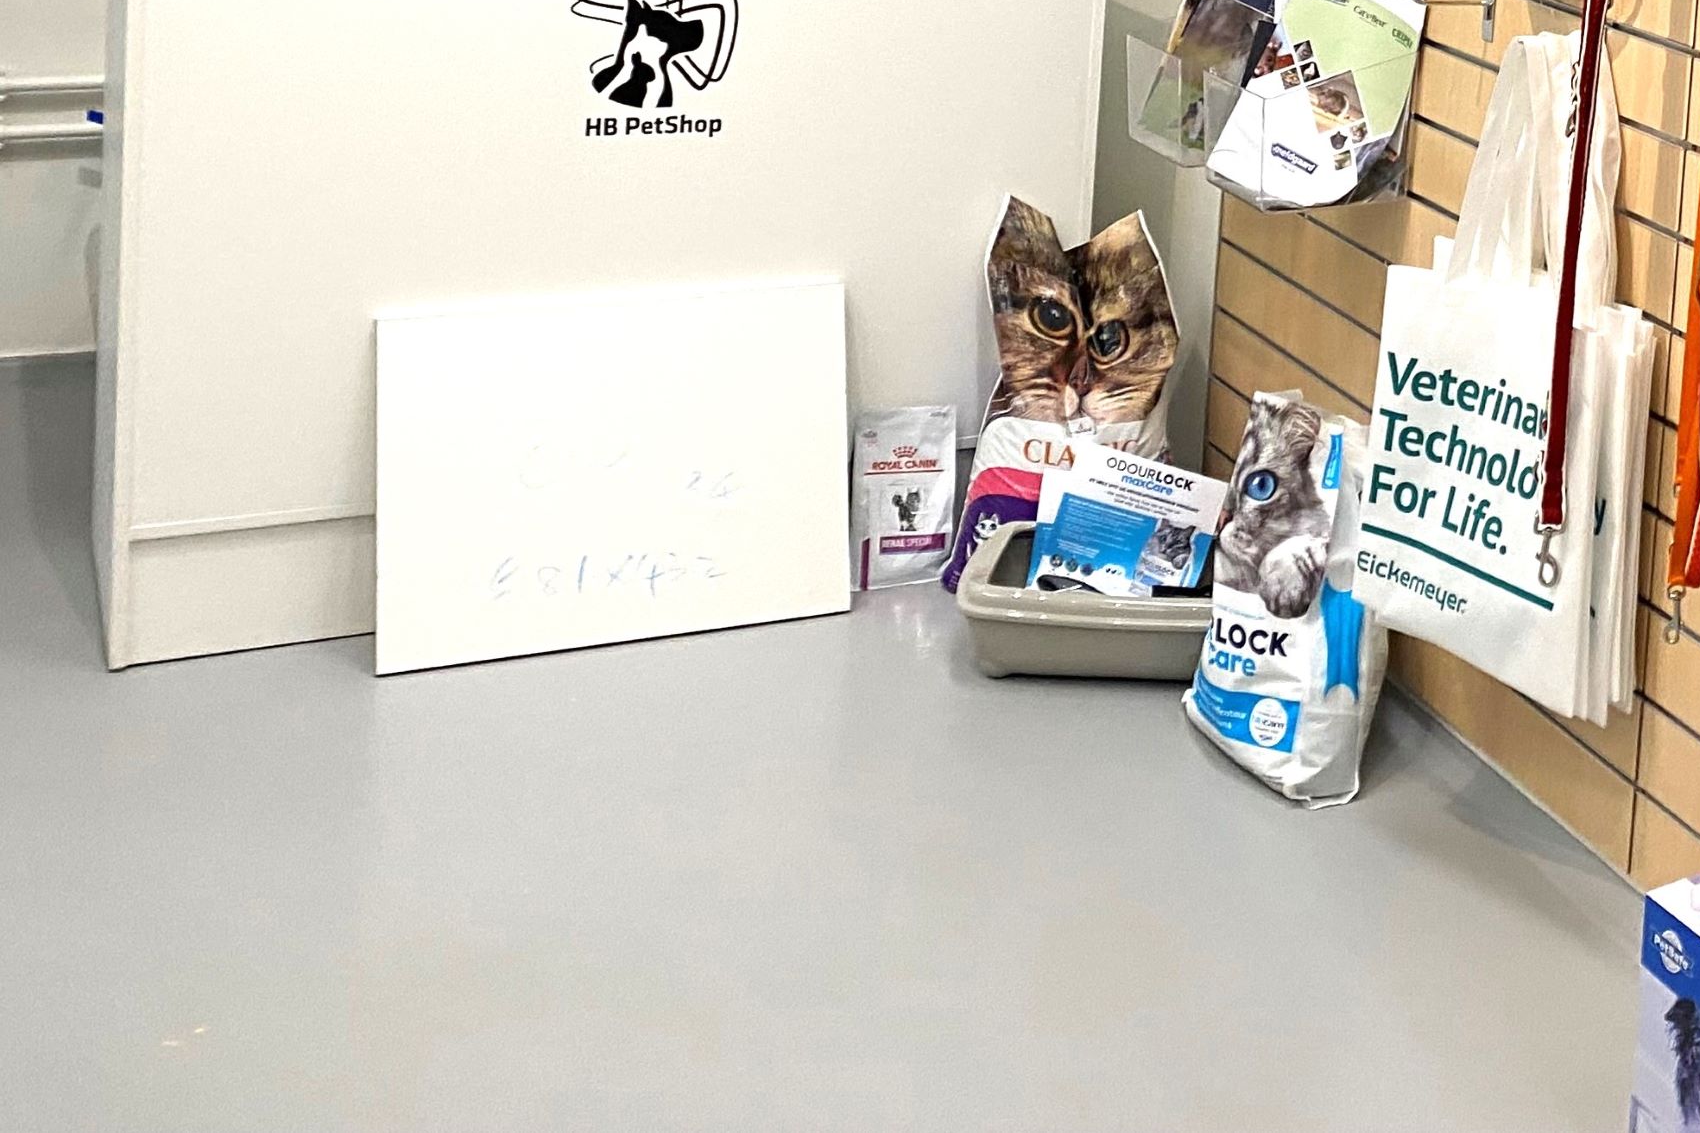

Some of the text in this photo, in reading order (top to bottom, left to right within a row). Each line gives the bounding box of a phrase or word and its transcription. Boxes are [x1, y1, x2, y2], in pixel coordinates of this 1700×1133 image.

[585, 114, 722, 137] HB PetShop
[1387, 351, 1549, 441] Veterinar
[872, 458, 937, 471] ROYAL CANIN
[1379, 408, 1539, 500] Technolo
[1107, 457, 1194, 492] ODOURLOCK
[1121, 475, 1173, 495] maxCare
[1368, 463, 1508, 556] For Life.
[1653, 933, 1689, 971] PetSafe
